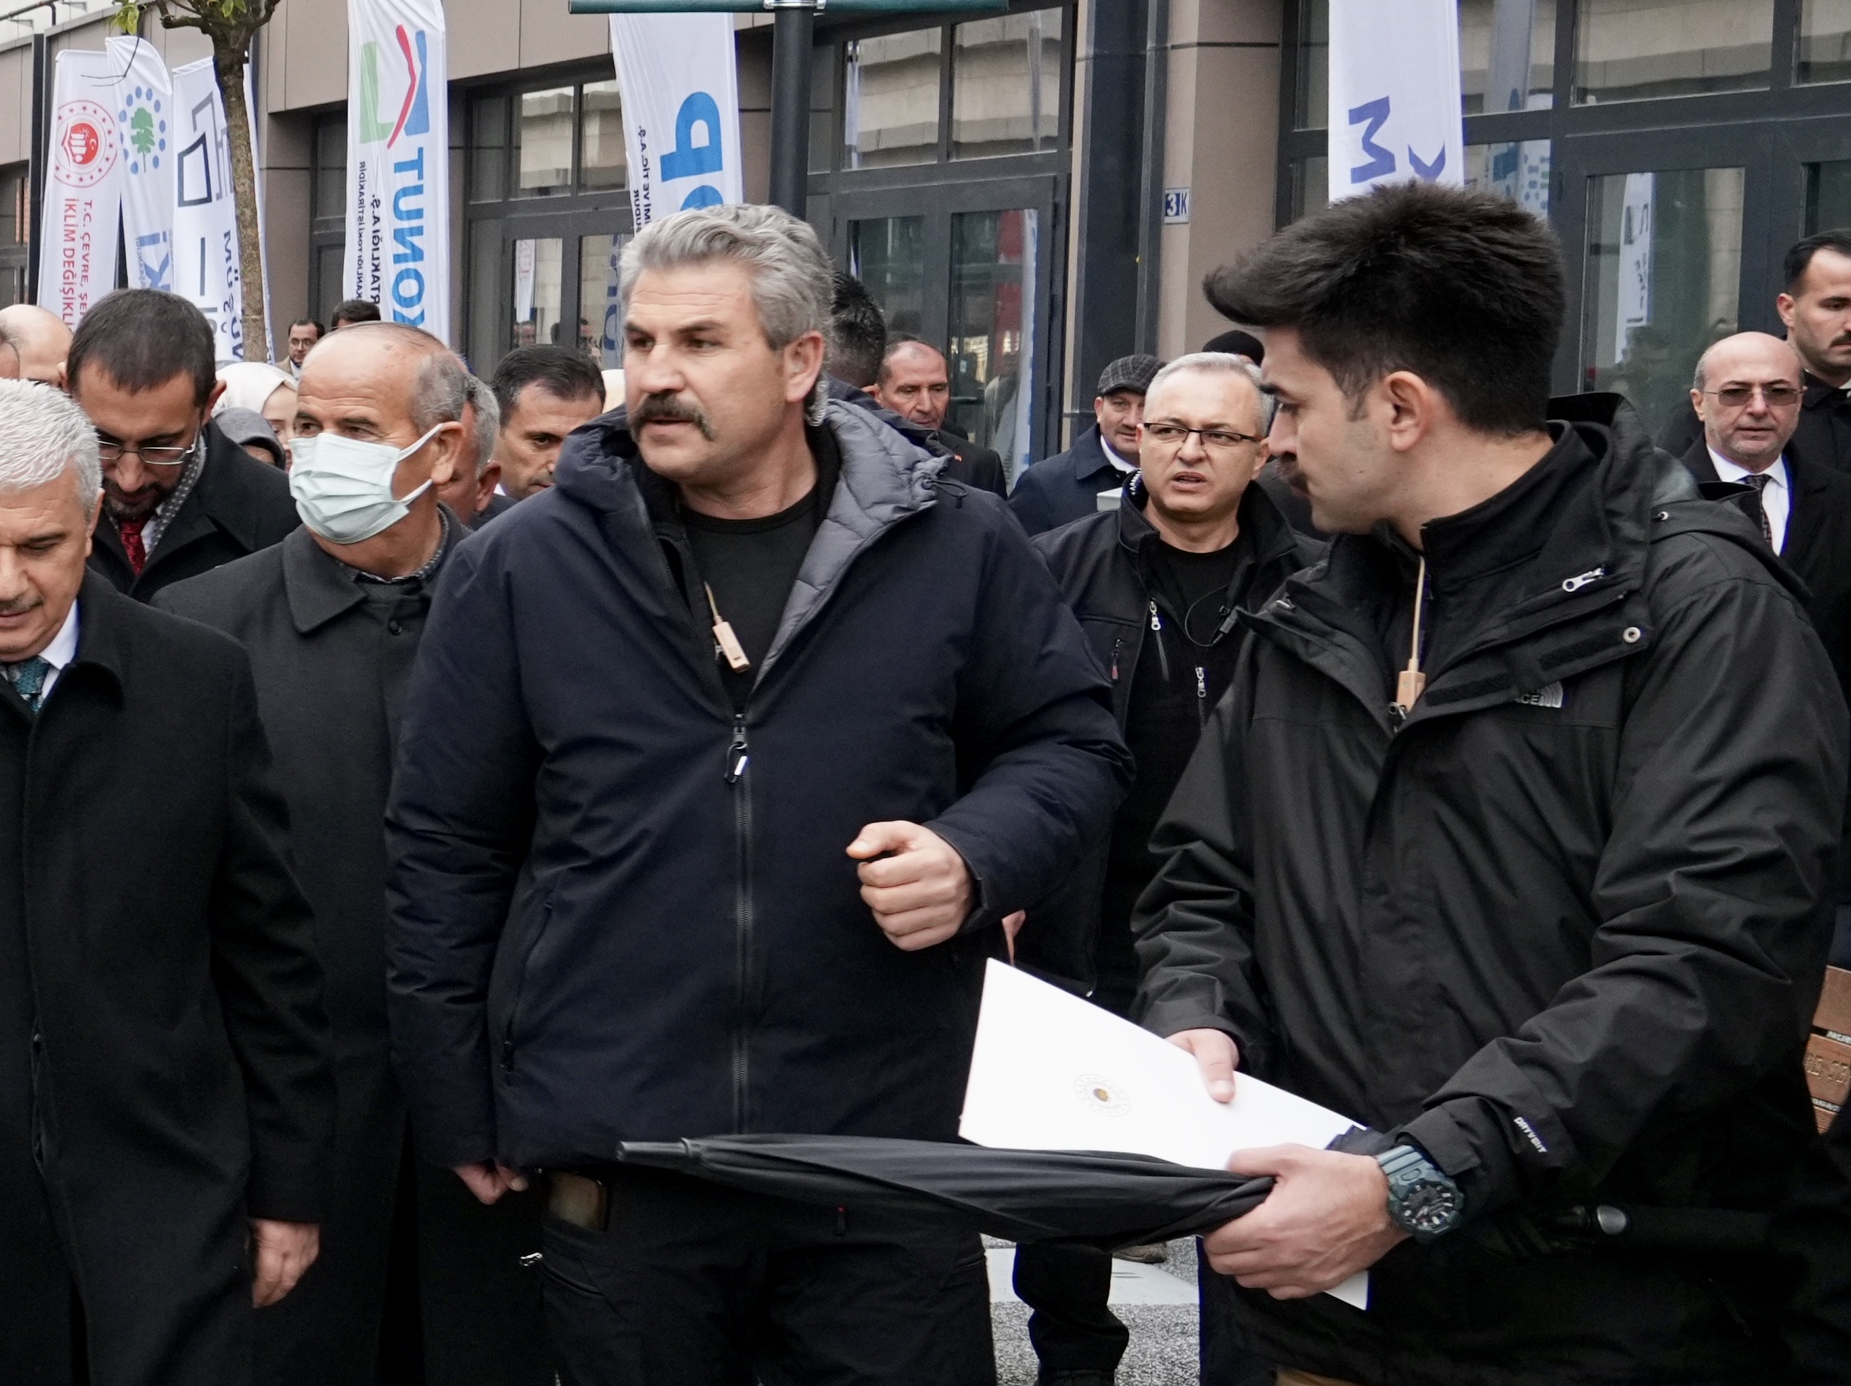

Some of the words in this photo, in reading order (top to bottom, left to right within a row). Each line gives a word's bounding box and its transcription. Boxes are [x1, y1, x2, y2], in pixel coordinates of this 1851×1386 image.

[63, 198, 79, 243] İKLİM
[82, 199, 93, 227] T.C.
[79, 231, 92, 288] ÇEVRE,
[60, 248, 78, 326] DEĞİŞİKLİ
[1521, 693, 1540, 706] CE
